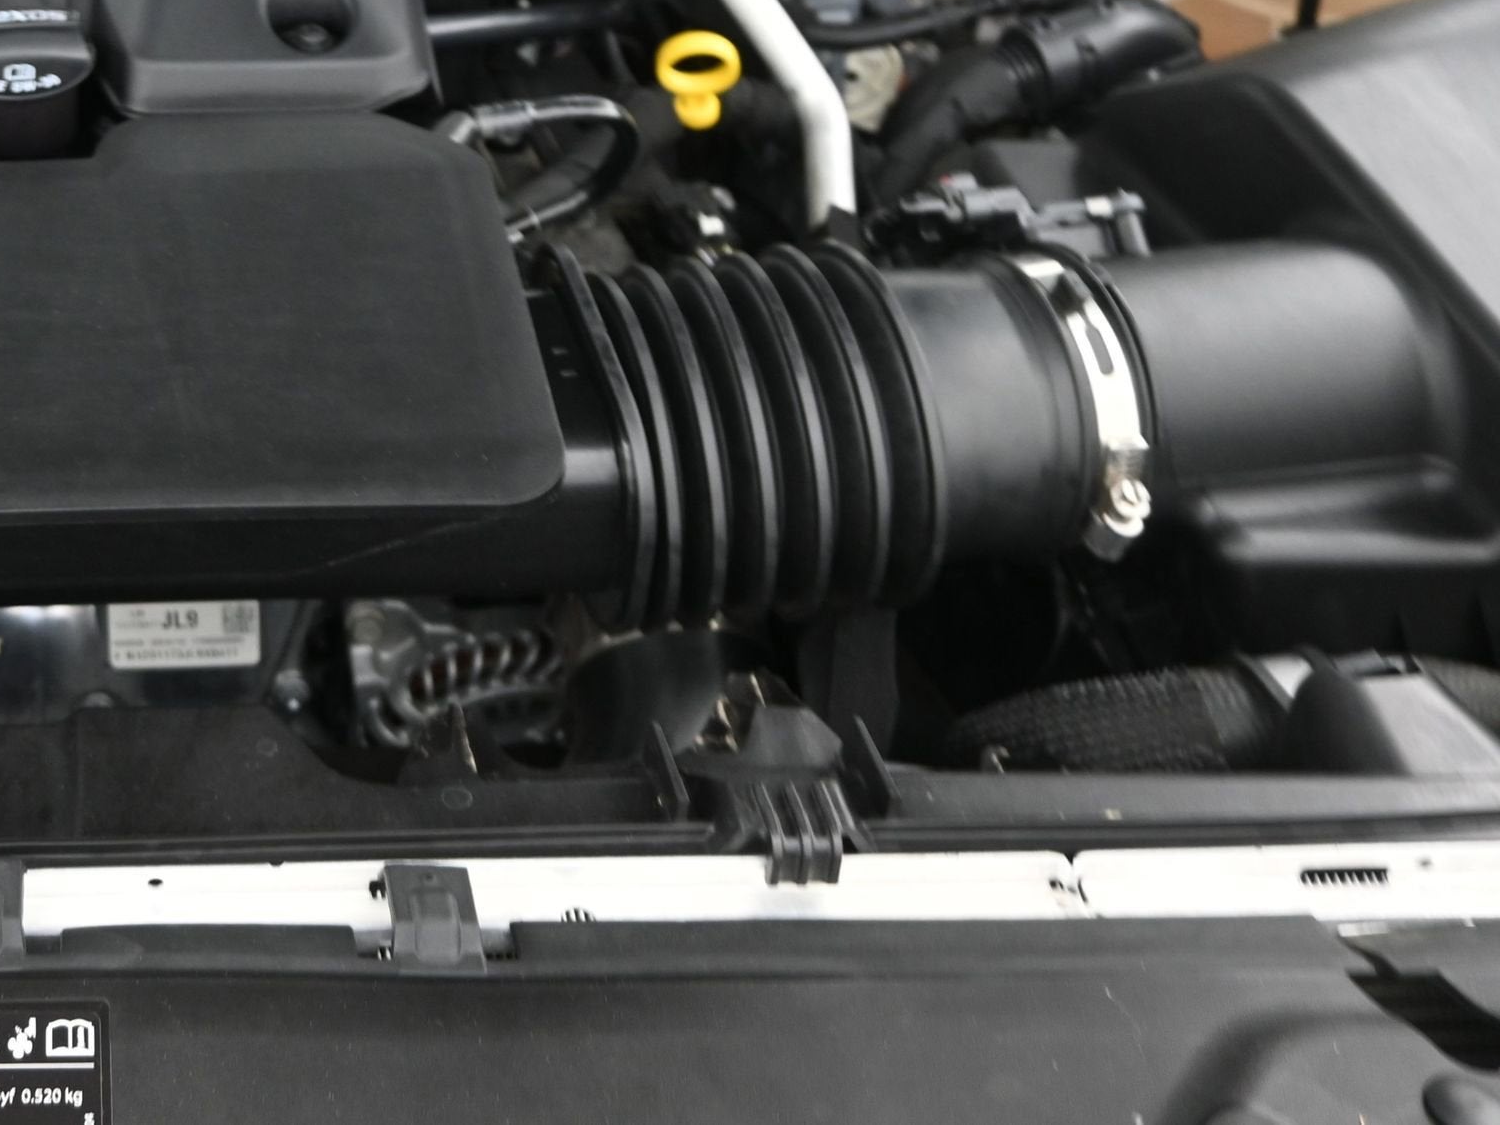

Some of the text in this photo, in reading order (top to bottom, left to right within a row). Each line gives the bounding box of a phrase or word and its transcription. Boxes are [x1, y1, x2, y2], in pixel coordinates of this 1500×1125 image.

[162, 609, 199, 629] JL9
[21, 1087, 62, 1105] 0.520
[64, 1087, 83, 1108] kg
